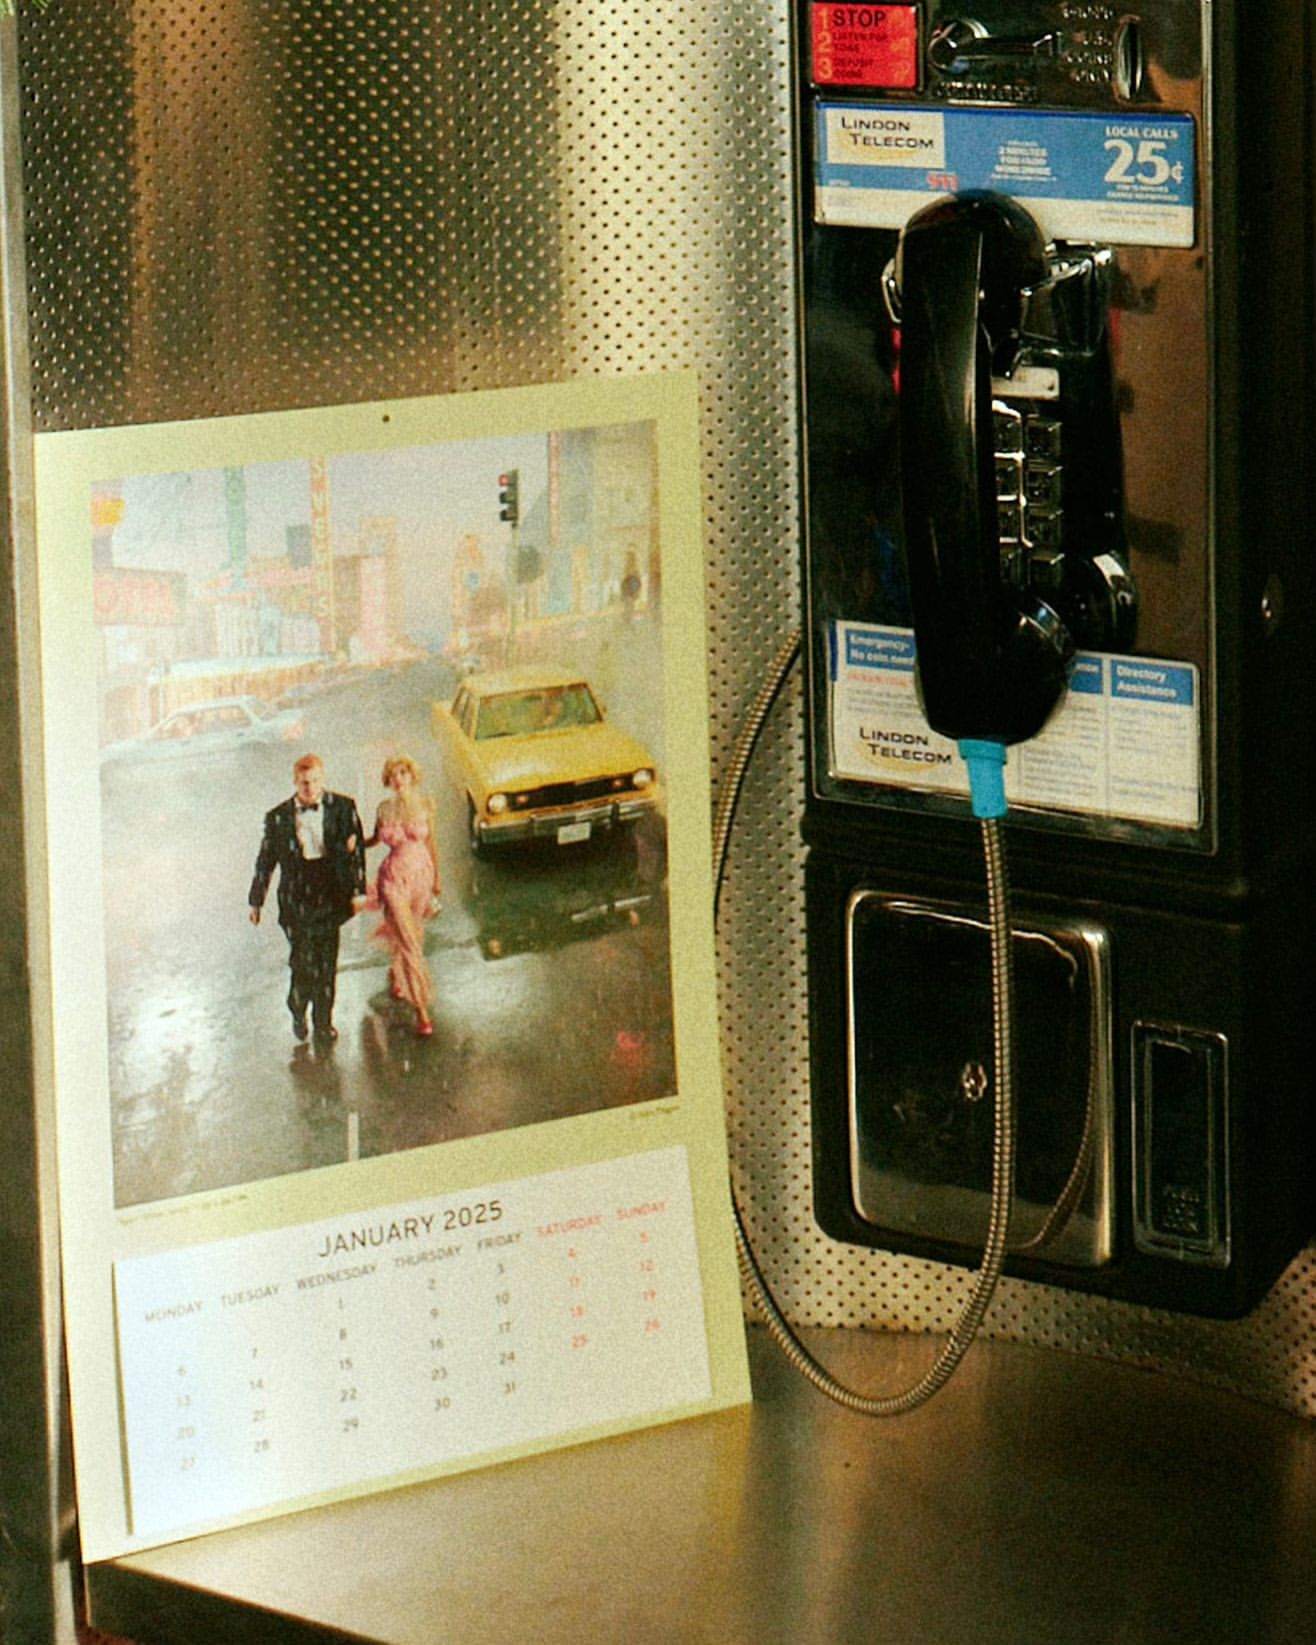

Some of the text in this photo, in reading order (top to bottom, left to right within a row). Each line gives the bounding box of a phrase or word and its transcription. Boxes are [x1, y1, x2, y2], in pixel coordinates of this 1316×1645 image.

[833, 8, 887, 28] STOP
[818, 32, 832, 54] 2
[819, 58, 832, 79] 3
[842, 116, 910, 131] LINDON
[1104, 125, 1179, 140] LOCAL CALLS
[849, 132, 935, 149] TELECOM
[859, 726, 929, 746] LINDON
[868, 743, 953, 765] TELECOM
[318, 1200, 504, 1258] JANUARY 2025
[145, 1200, 668, 1323] MONDAY TUESDAY WEDNESDAY THURSDAY FRIDAY SATURDAY SUNDAY
